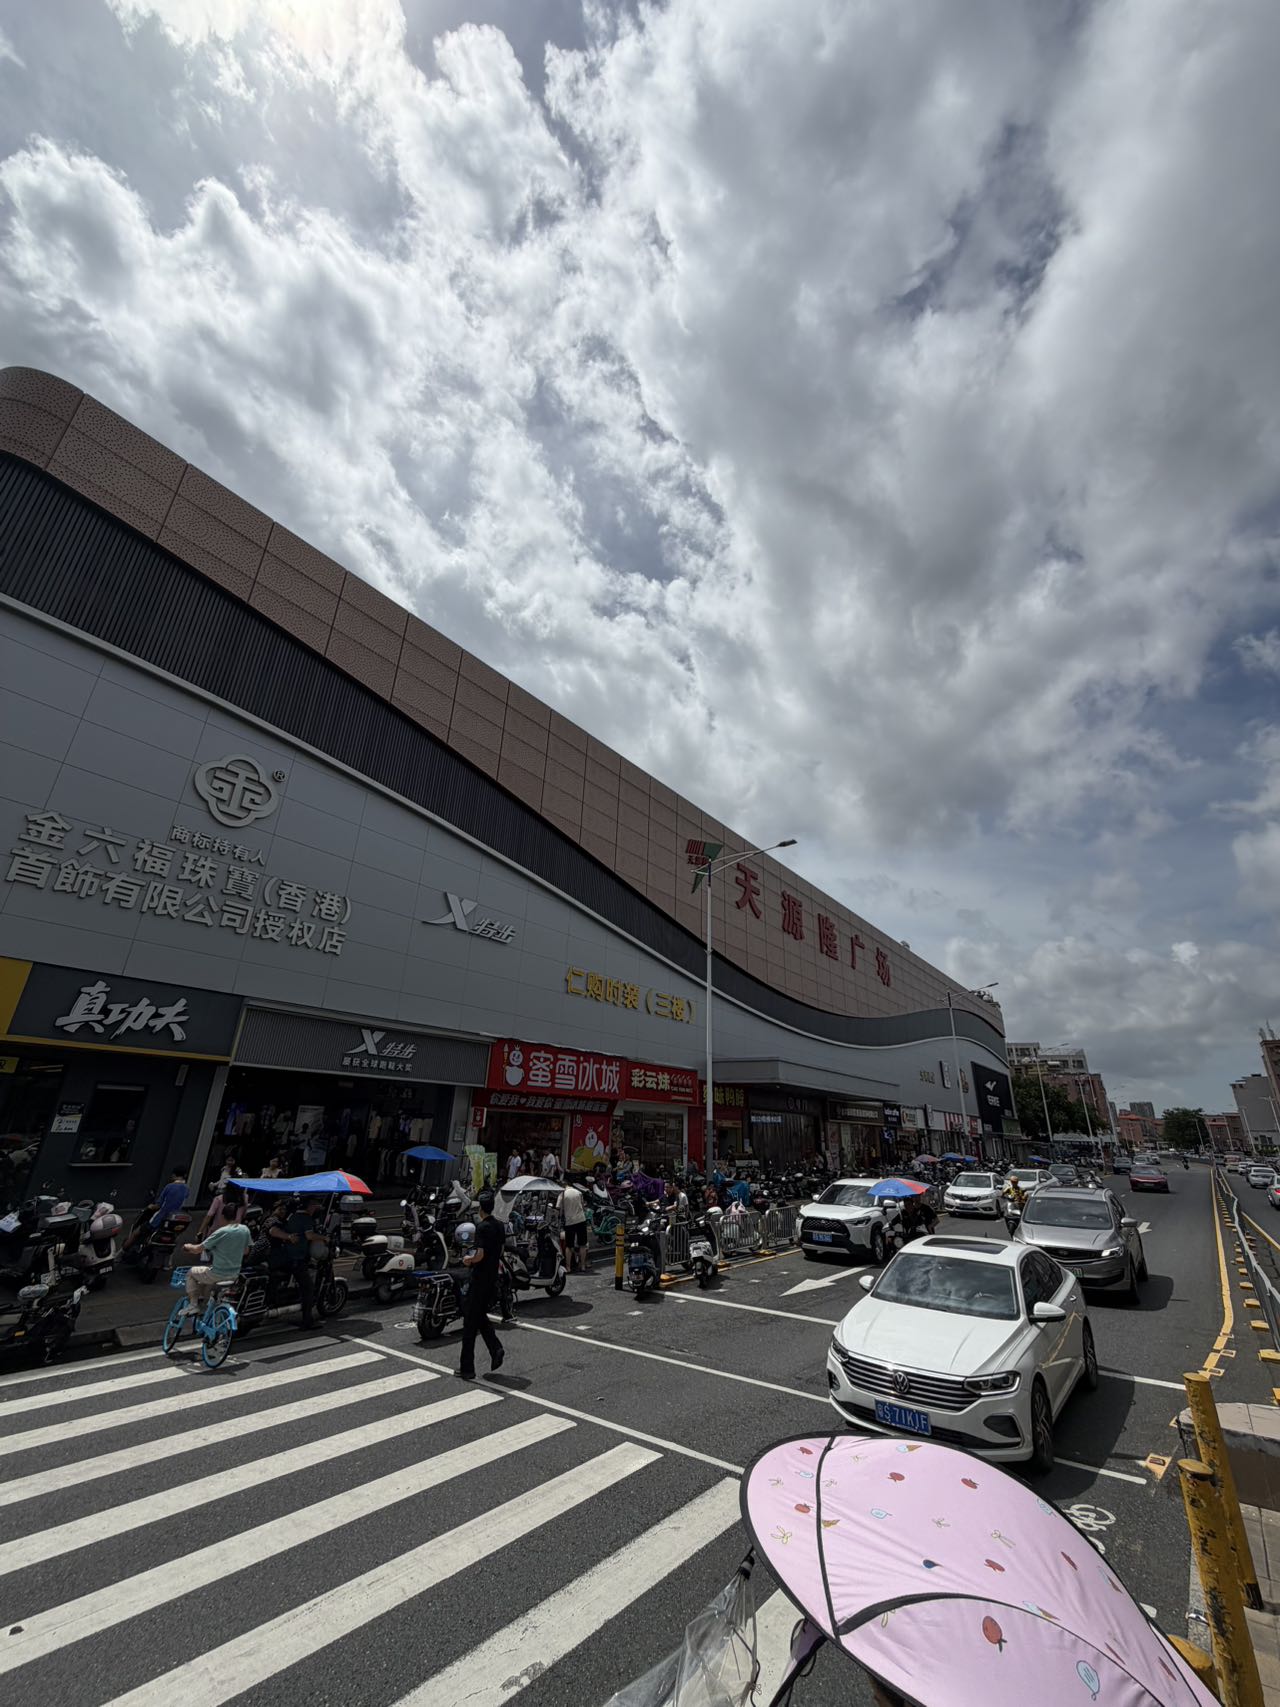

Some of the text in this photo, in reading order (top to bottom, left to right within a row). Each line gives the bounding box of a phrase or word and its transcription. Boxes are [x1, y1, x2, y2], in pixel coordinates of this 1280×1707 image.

[170, 825, 266, 867] 商标持有人
[6, 847, 348, 956] 首飾有限公司授权店
[735, 863, 891, 987] 天源隆广场
[468, 917, 519, 945] 特步
[55, 980, 190, 1042] 真功夫
[565, 966, 698, 1025] 仁购时装（三楼）
[379, 1041, 417, 1060] 特步
[527, 1050, 620, 1095] 蜜雪冰城
